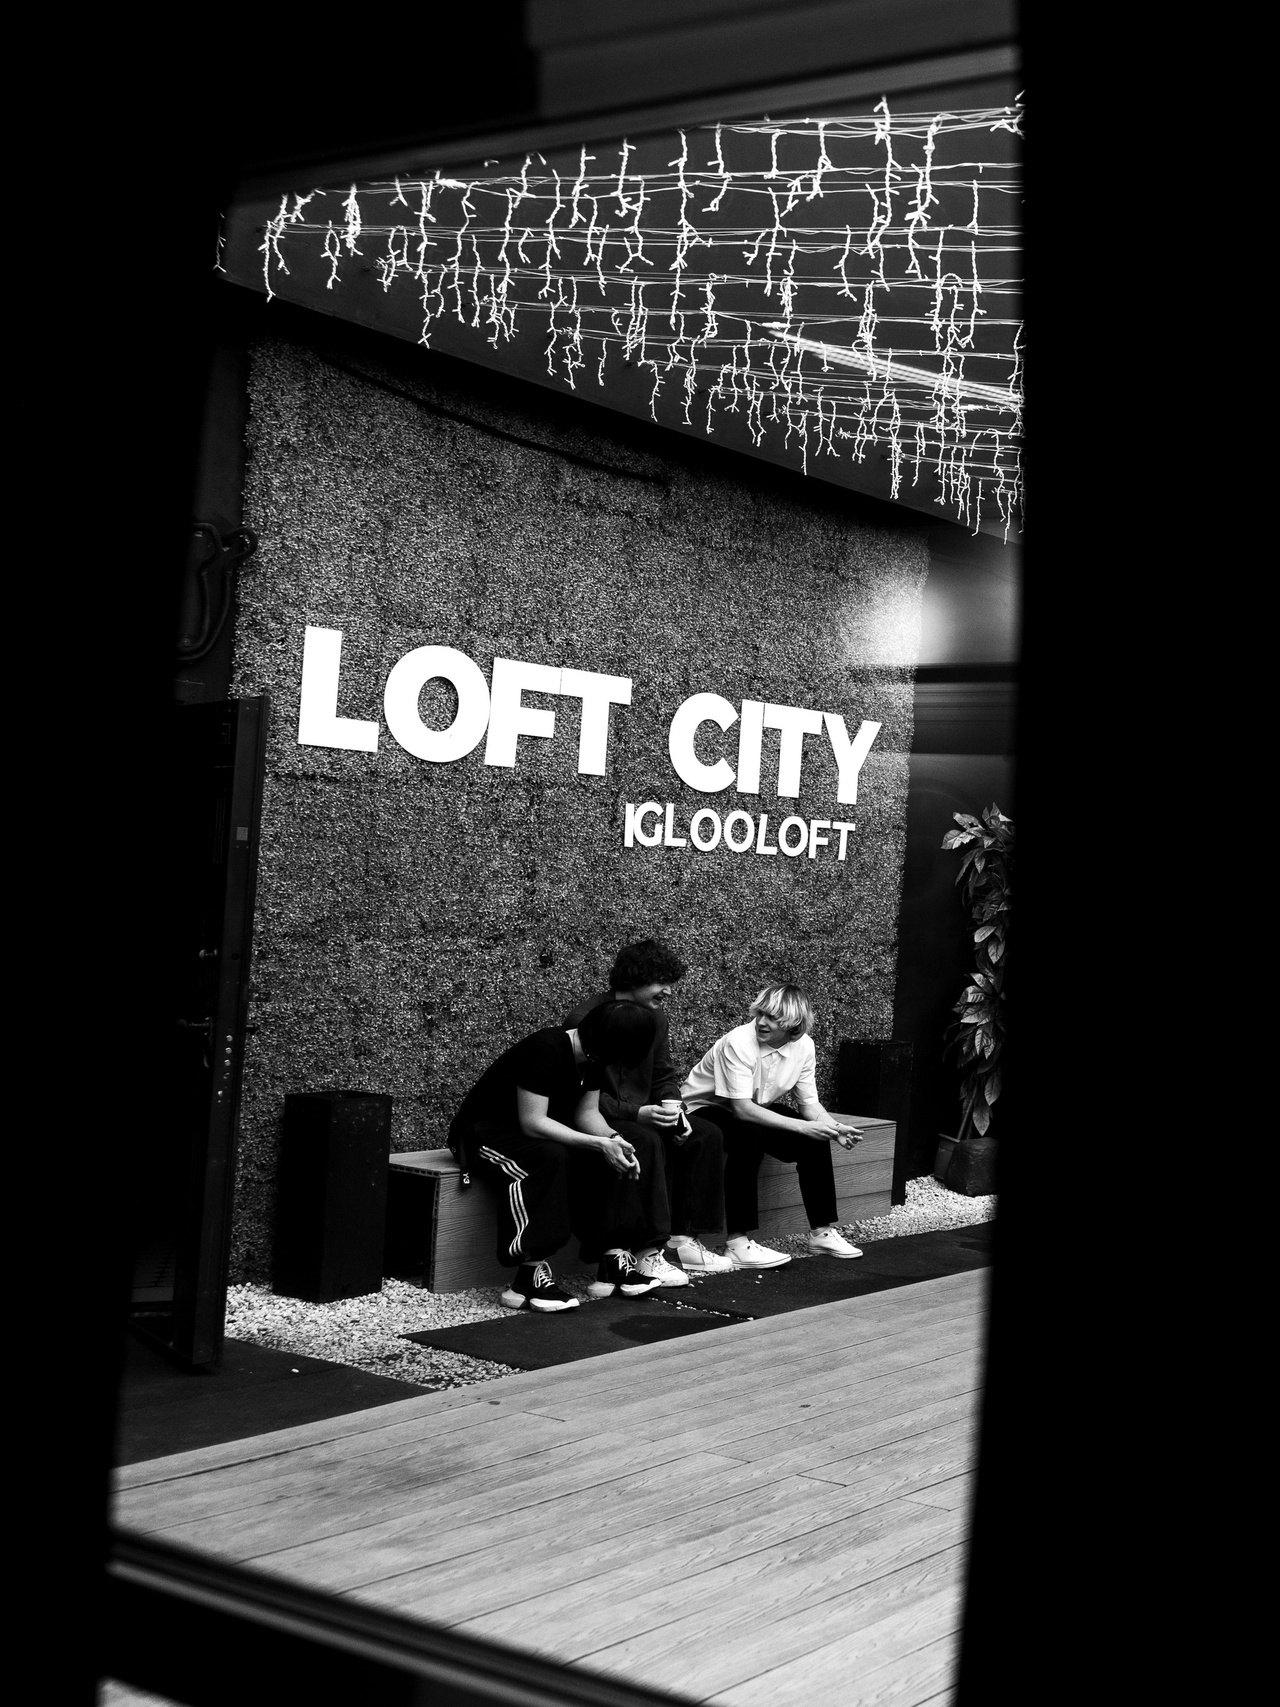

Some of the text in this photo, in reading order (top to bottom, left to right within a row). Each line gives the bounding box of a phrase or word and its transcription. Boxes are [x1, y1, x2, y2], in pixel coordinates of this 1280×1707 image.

[298, 625, 883, 805] LOFT CITY
[624, 801, 856, 861] IGLOOLOFT
